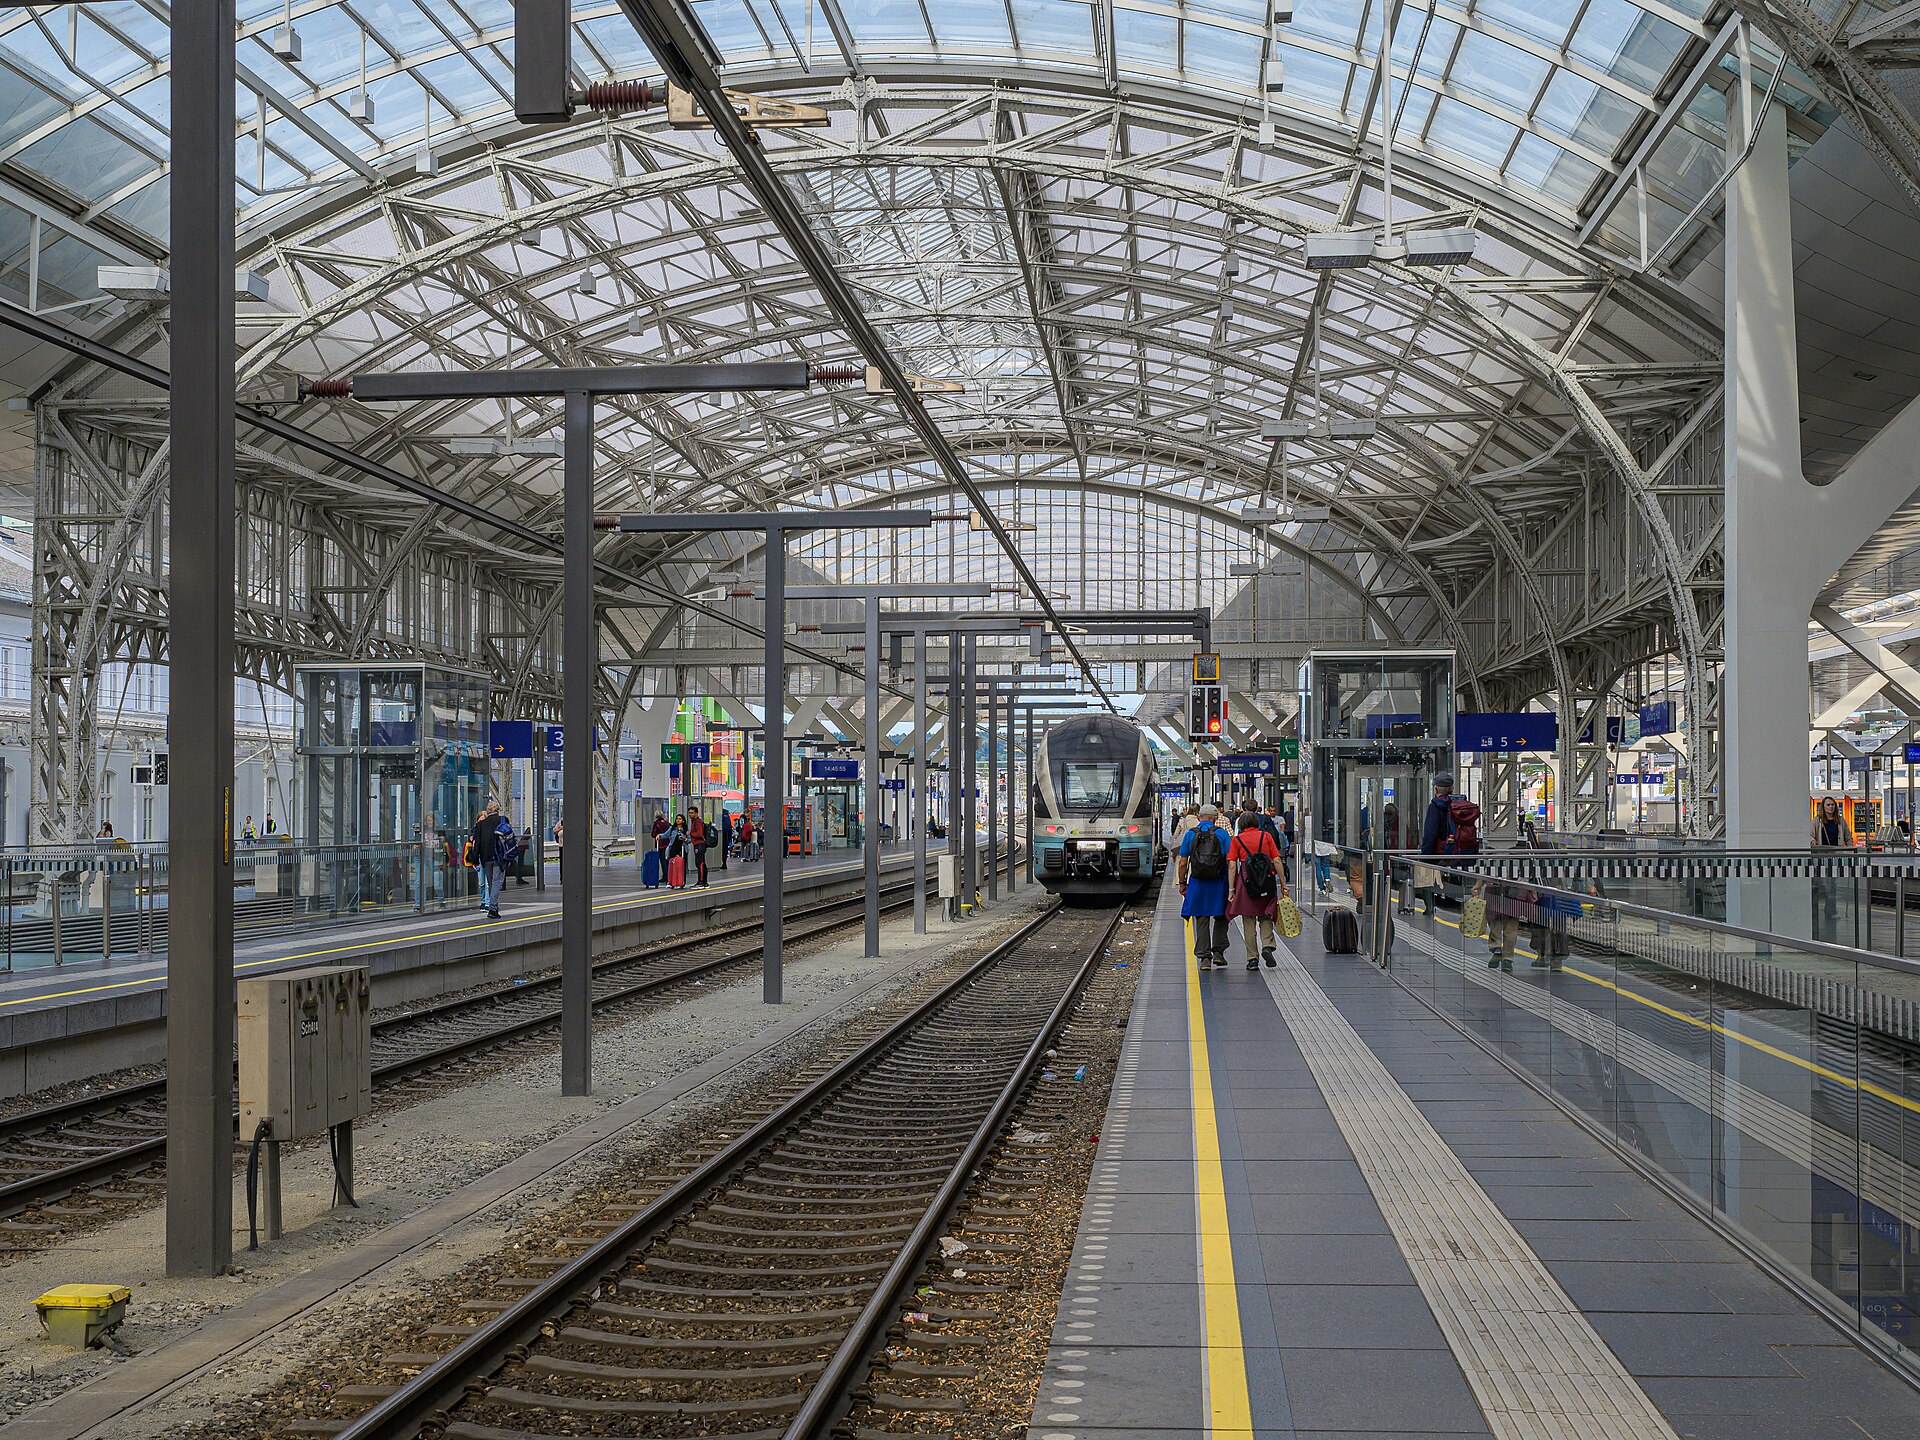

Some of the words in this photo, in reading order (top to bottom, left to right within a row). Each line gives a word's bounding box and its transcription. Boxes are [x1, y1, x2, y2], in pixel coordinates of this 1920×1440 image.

[553, 731, 564, 747] 3
[1500, 736, 1508, 747] 5
[1619, 775, 1625, 783] 6
[1645, 775, 1651, 783] 7
